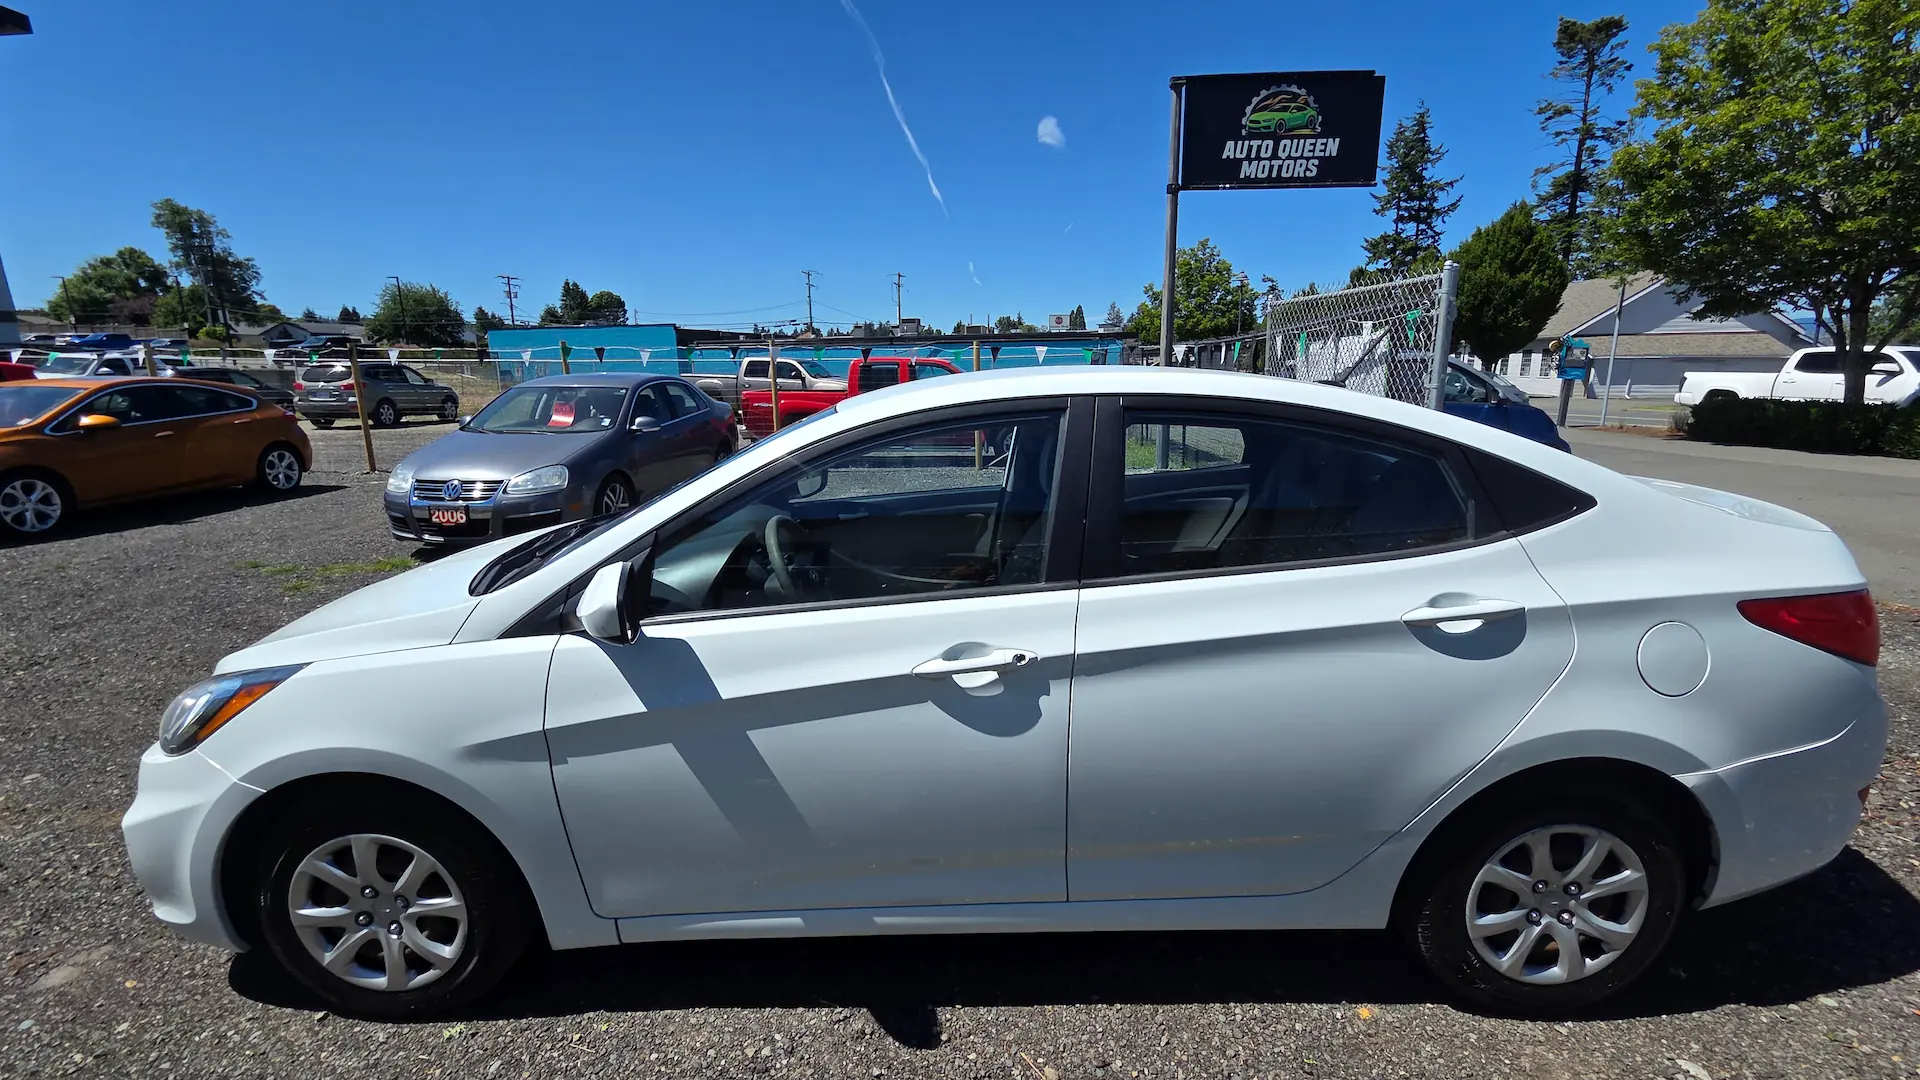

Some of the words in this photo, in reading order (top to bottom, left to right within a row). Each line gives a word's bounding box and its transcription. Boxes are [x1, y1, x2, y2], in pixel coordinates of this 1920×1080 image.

[1222, 140, 1273, 159] AUTO
[1278, 138, 1340, 160] QUEEN
[1240, 160, 1319, 179] MOTORS
[431, 510, 467, 523] 2006
